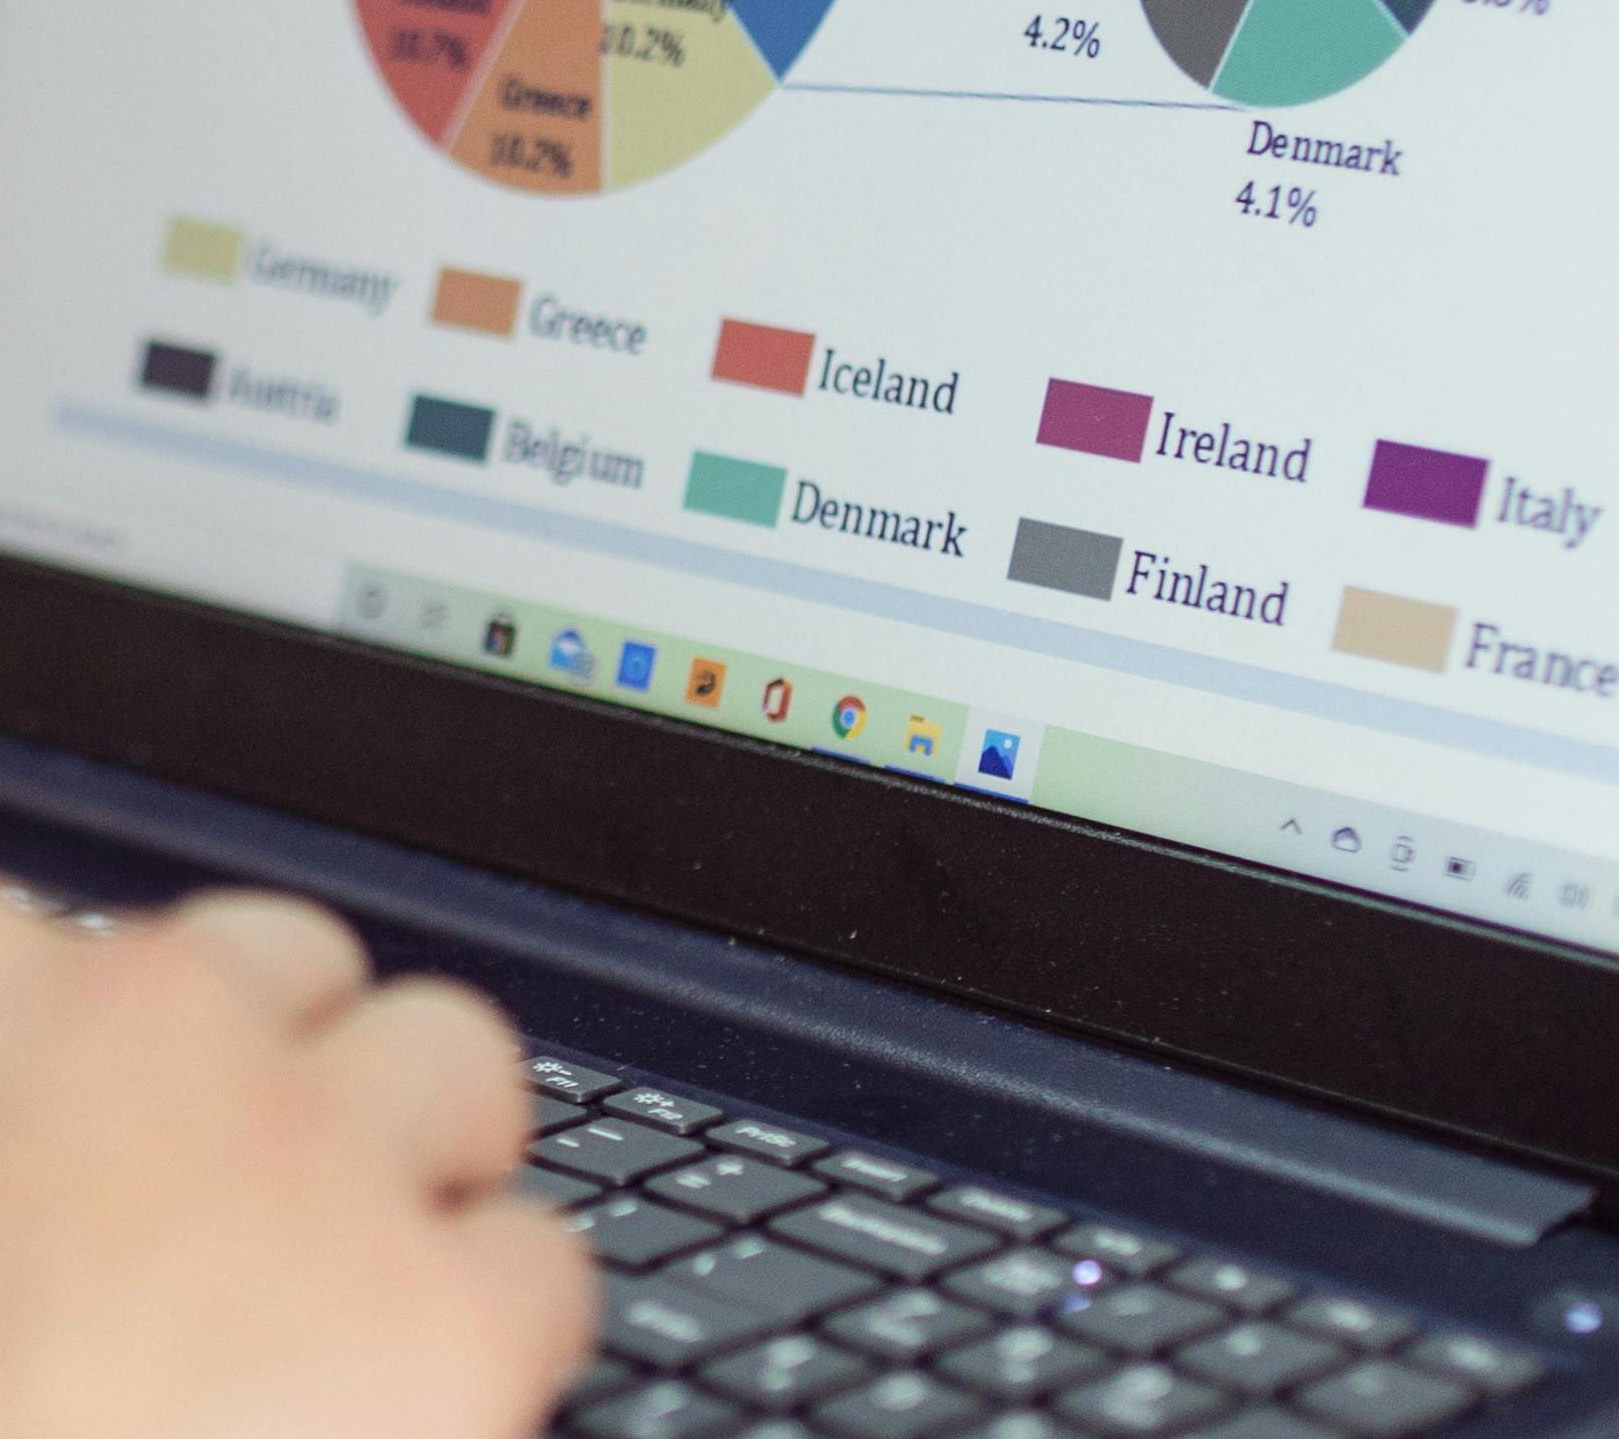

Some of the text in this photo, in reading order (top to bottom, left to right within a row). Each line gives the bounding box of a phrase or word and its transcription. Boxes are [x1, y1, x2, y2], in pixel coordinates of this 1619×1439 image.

[598, 22, 686, 68] 10.2%
[1023, 14, 1101, 59] 4.2%
[501, 73, 593, 121] Greece
[1246, 120, 1404, 177] Denmark
[1236, 181, 1318, 228] 4.1%
[252, 241, 1604, 551] Germany Greece Iceland Ireland Italy
[505, 418, 646, 489] Belgium
[790, 479, 968, 558] Denmark
[1125, 550, 1291, 627] Finland
[545, 1075, 579, 1089] F11
